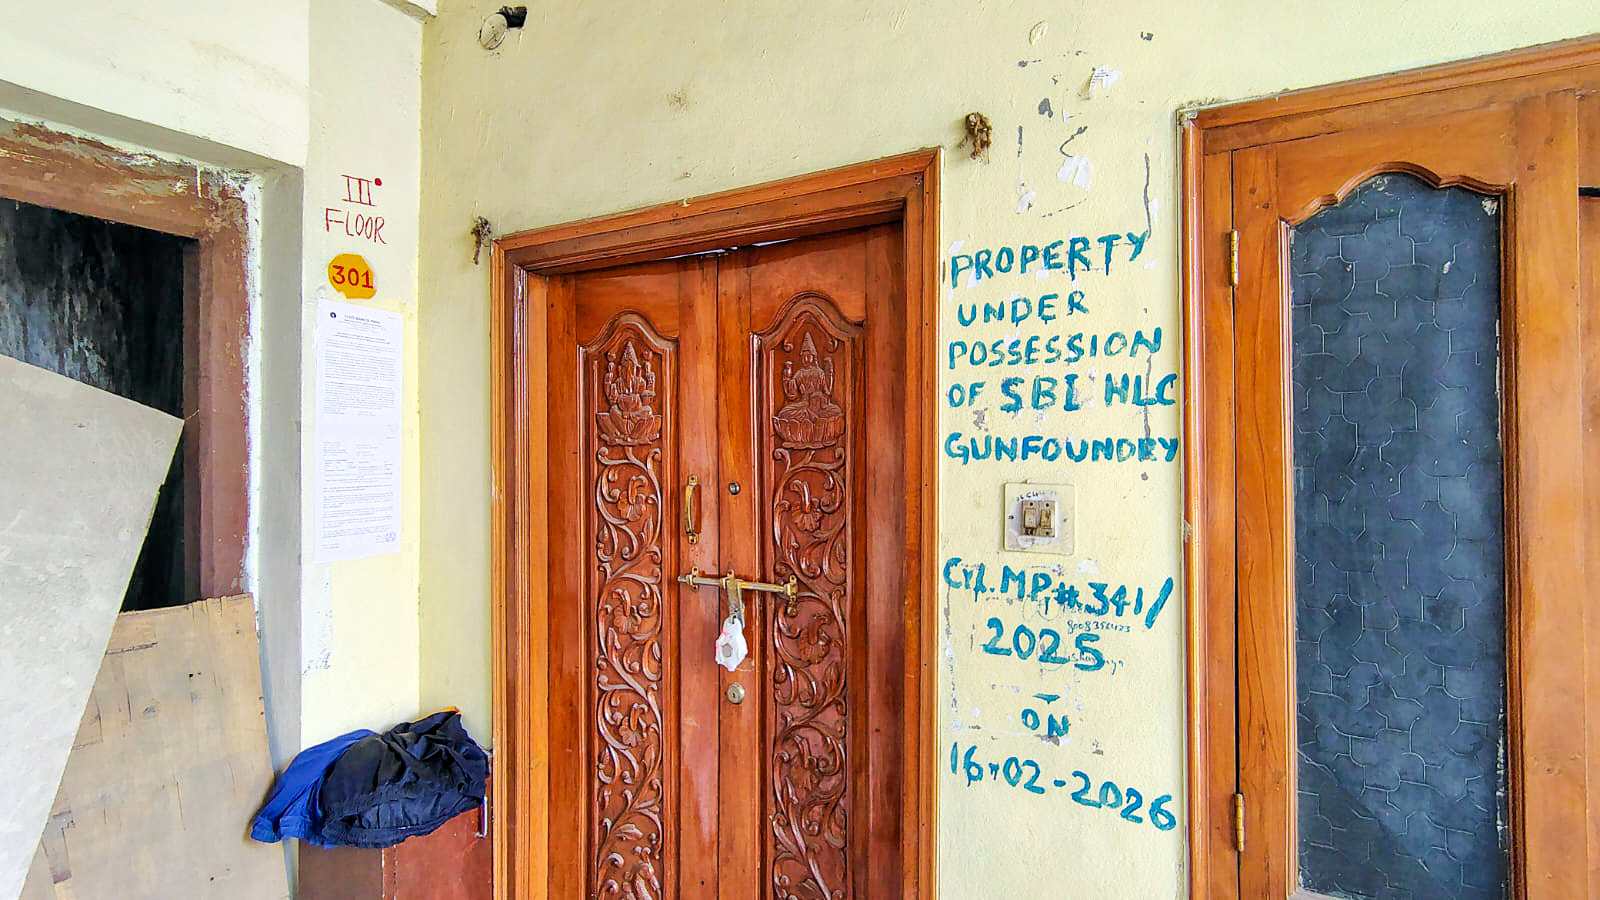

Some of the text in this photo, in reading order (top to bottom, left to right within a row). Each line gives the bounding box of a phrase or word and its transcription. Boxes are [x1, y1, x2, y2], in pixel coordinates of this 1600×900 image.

[325, 207, 388, 245] FLOOR
[332, 264, 374, 289] 301
[951, 230, 1148, 289] PROPERTY
[958, 290, 1089, 327] UNDER
[949, 327, 1162, 370] POSSESSION
[948, 373, 1177, 413] OF SBI HLC
[944, 431, 1179, 465] GUNFOUNDRY
[983, 617, 1106, 672] 2025
[1021, 708, 1069, 738] ON
